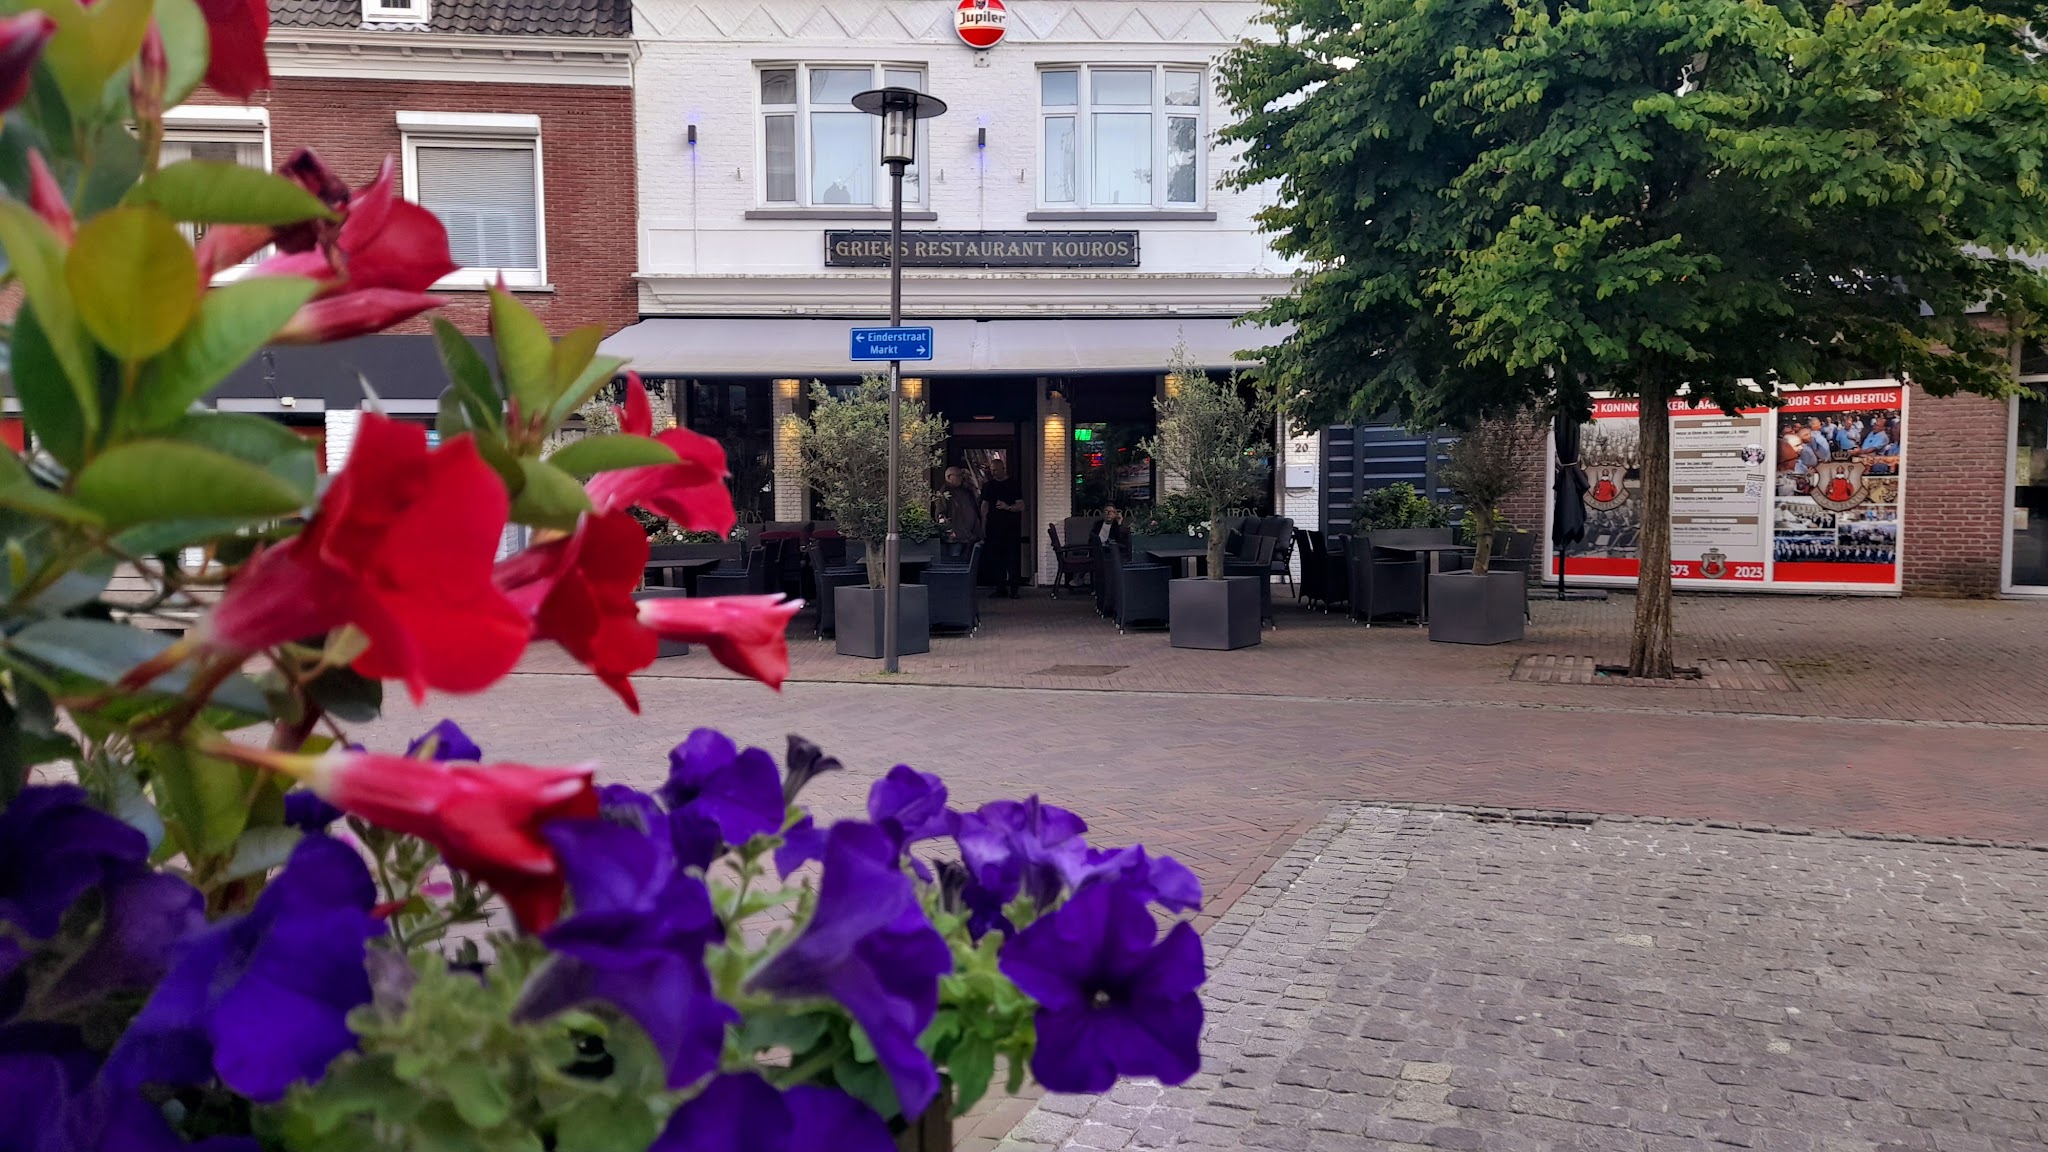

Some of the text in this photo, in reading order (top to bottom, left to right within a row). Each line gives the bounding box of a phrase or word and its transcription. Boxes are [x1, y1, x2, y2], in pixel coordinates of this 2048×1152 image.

[959, 10, 1006, 25] Jupiler
[835, 240, 1129, 257] GRIEKS RESTAURANT KOUROS
[867, 332, 927, 342] Einderstraat
[870, 345, 899, 355] Markt
[1831, 392, 1897, 405] LAMBERTUS
[1295, 443, 1309, 453] 20
[1734, 566, 1763, 578] 2023
